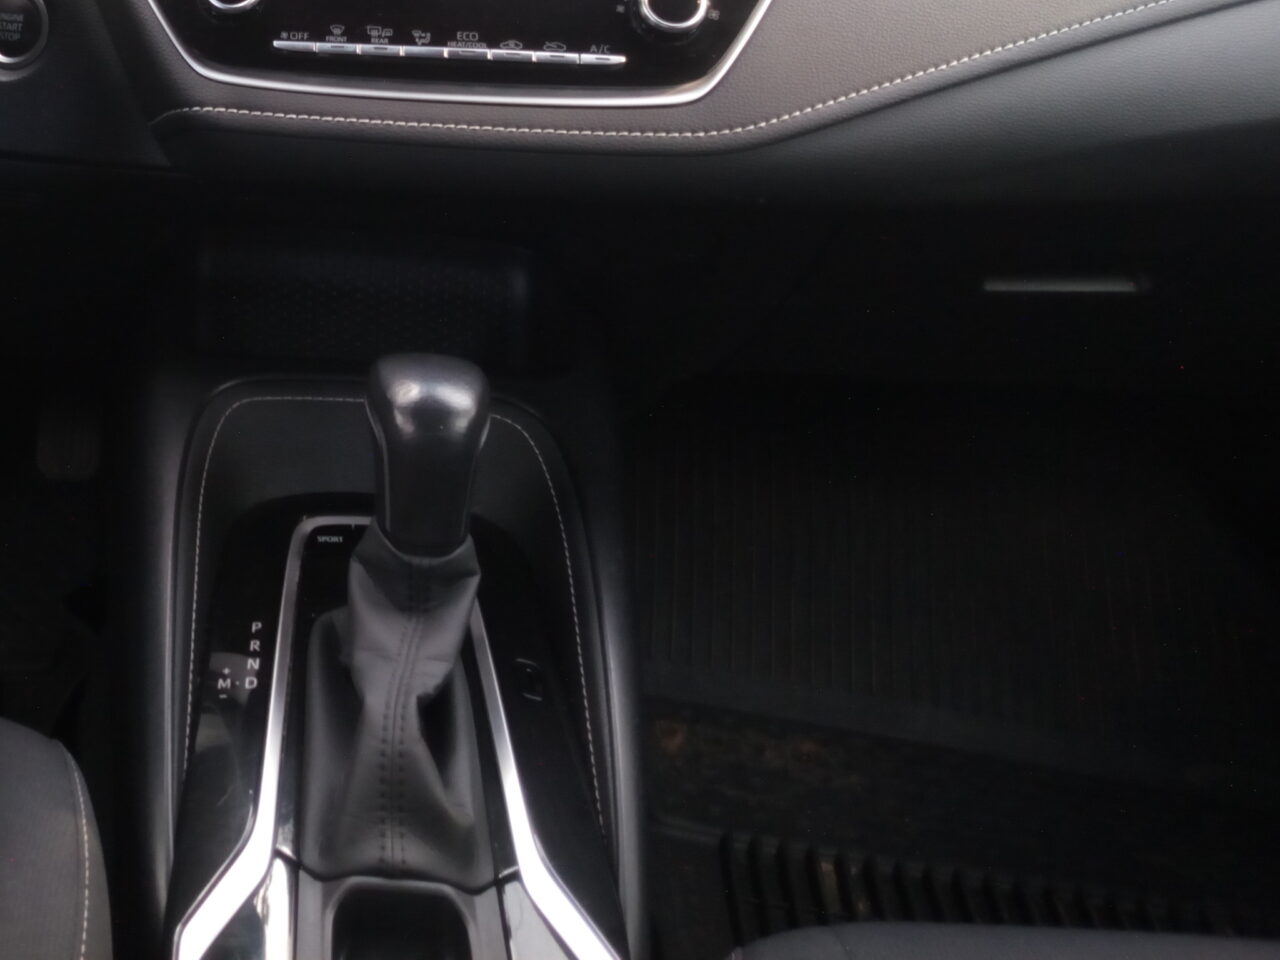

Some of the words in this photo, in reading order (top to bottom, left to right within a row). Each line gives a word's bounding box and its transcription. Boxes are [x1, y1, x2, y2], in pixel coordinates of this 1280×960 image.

[290, 32, 310, 40] OFF
[456, 31, 479, 41] ECO
[590, 44, 611, 54] A/C
[317, 535, 343, 543] SPORT
[252, 621, 262, 633] P
[250, 640, 261, 652] R
[247, 658, 260, 670] N
[217, 678, 231, 690] M
[244, 677, 258, 689] D
